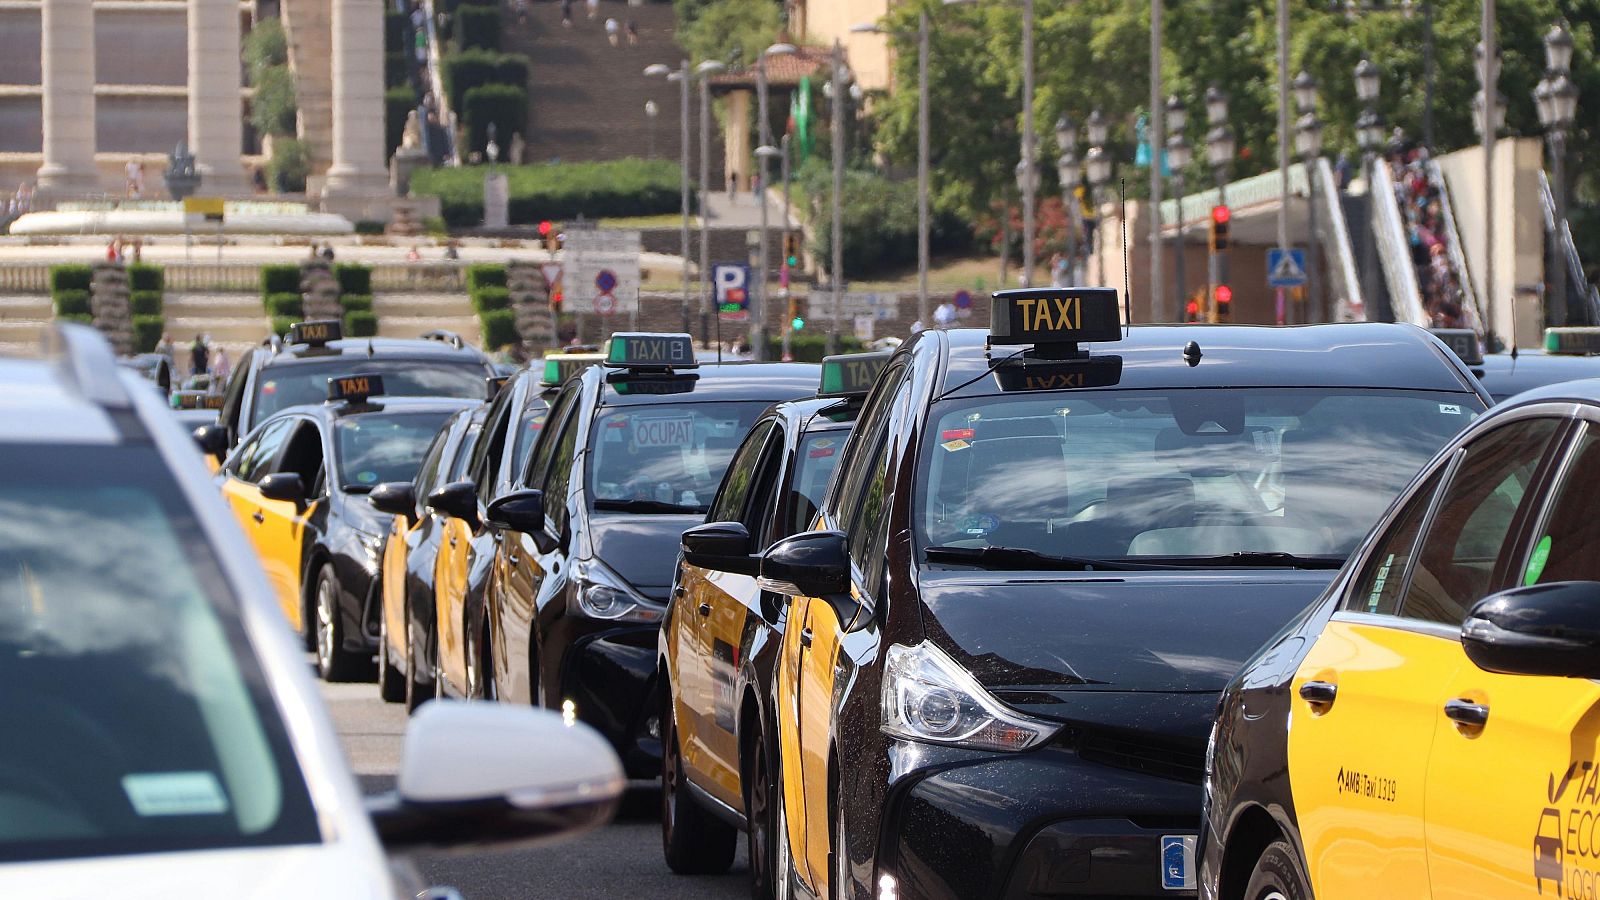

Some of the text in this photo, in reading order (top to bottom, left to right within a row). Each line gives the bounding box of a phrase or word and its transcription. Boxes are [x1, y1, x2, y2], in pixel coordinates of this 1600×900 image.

[1016, 298, 1081, 331] TAXI
[302, 324, 328, 338] TAXI
[630, 340, 666, 361] TAXI
[339, 377, 370, 395] TAXI
[636, 420, 692, 448] OCUPAT
